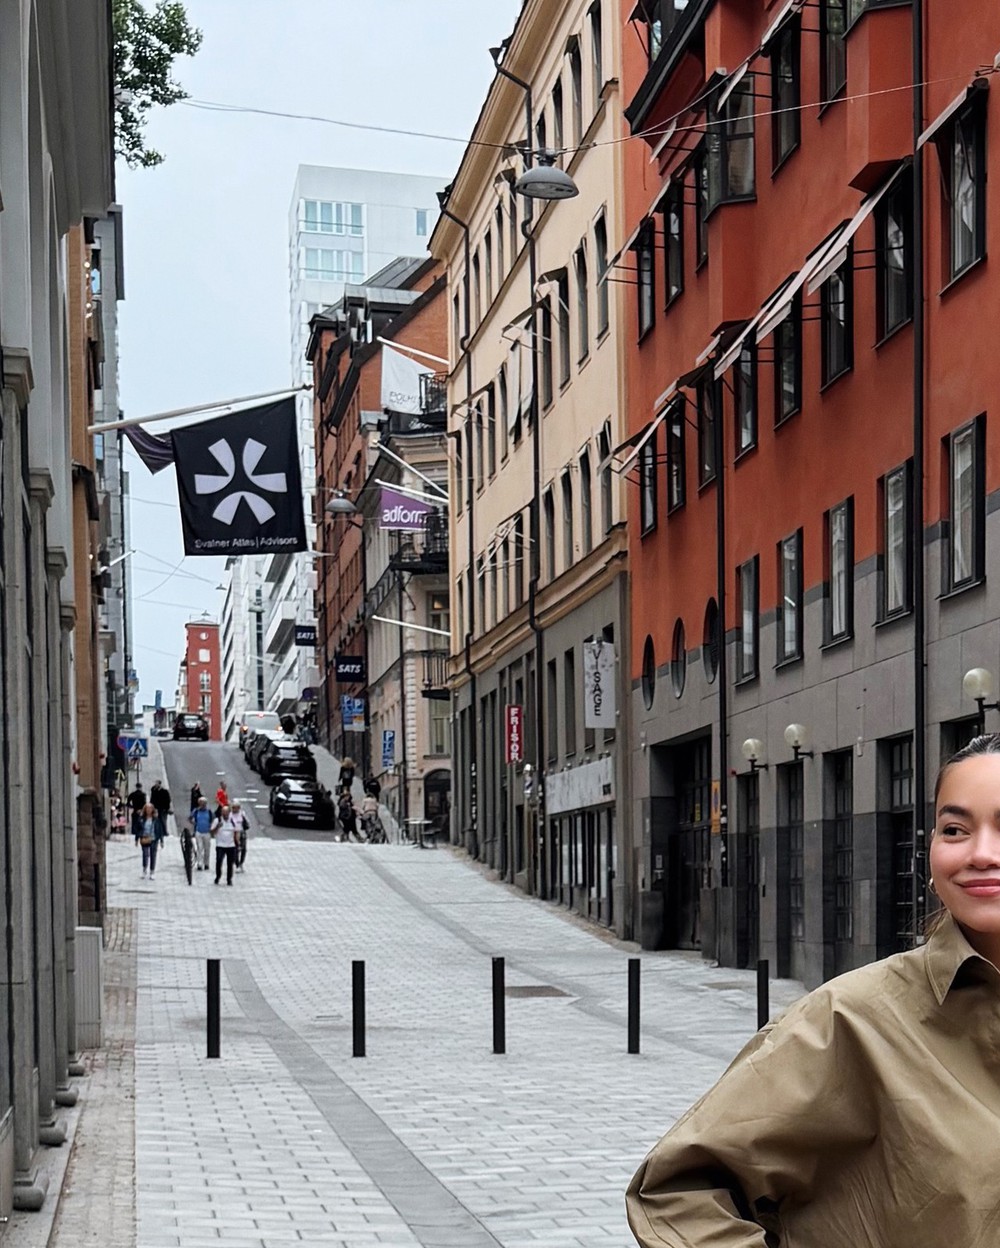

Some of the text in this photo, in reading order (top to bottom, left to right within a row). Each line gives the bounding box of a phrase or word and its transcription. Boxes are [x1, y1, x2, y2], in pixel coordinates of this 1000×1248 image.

[260, 536, 298, 546] Advisors
[296, 632, 315, 640] SATS
[338, 664, 361, 673] SATS
[593, 649, 602, 716] VISAGE
